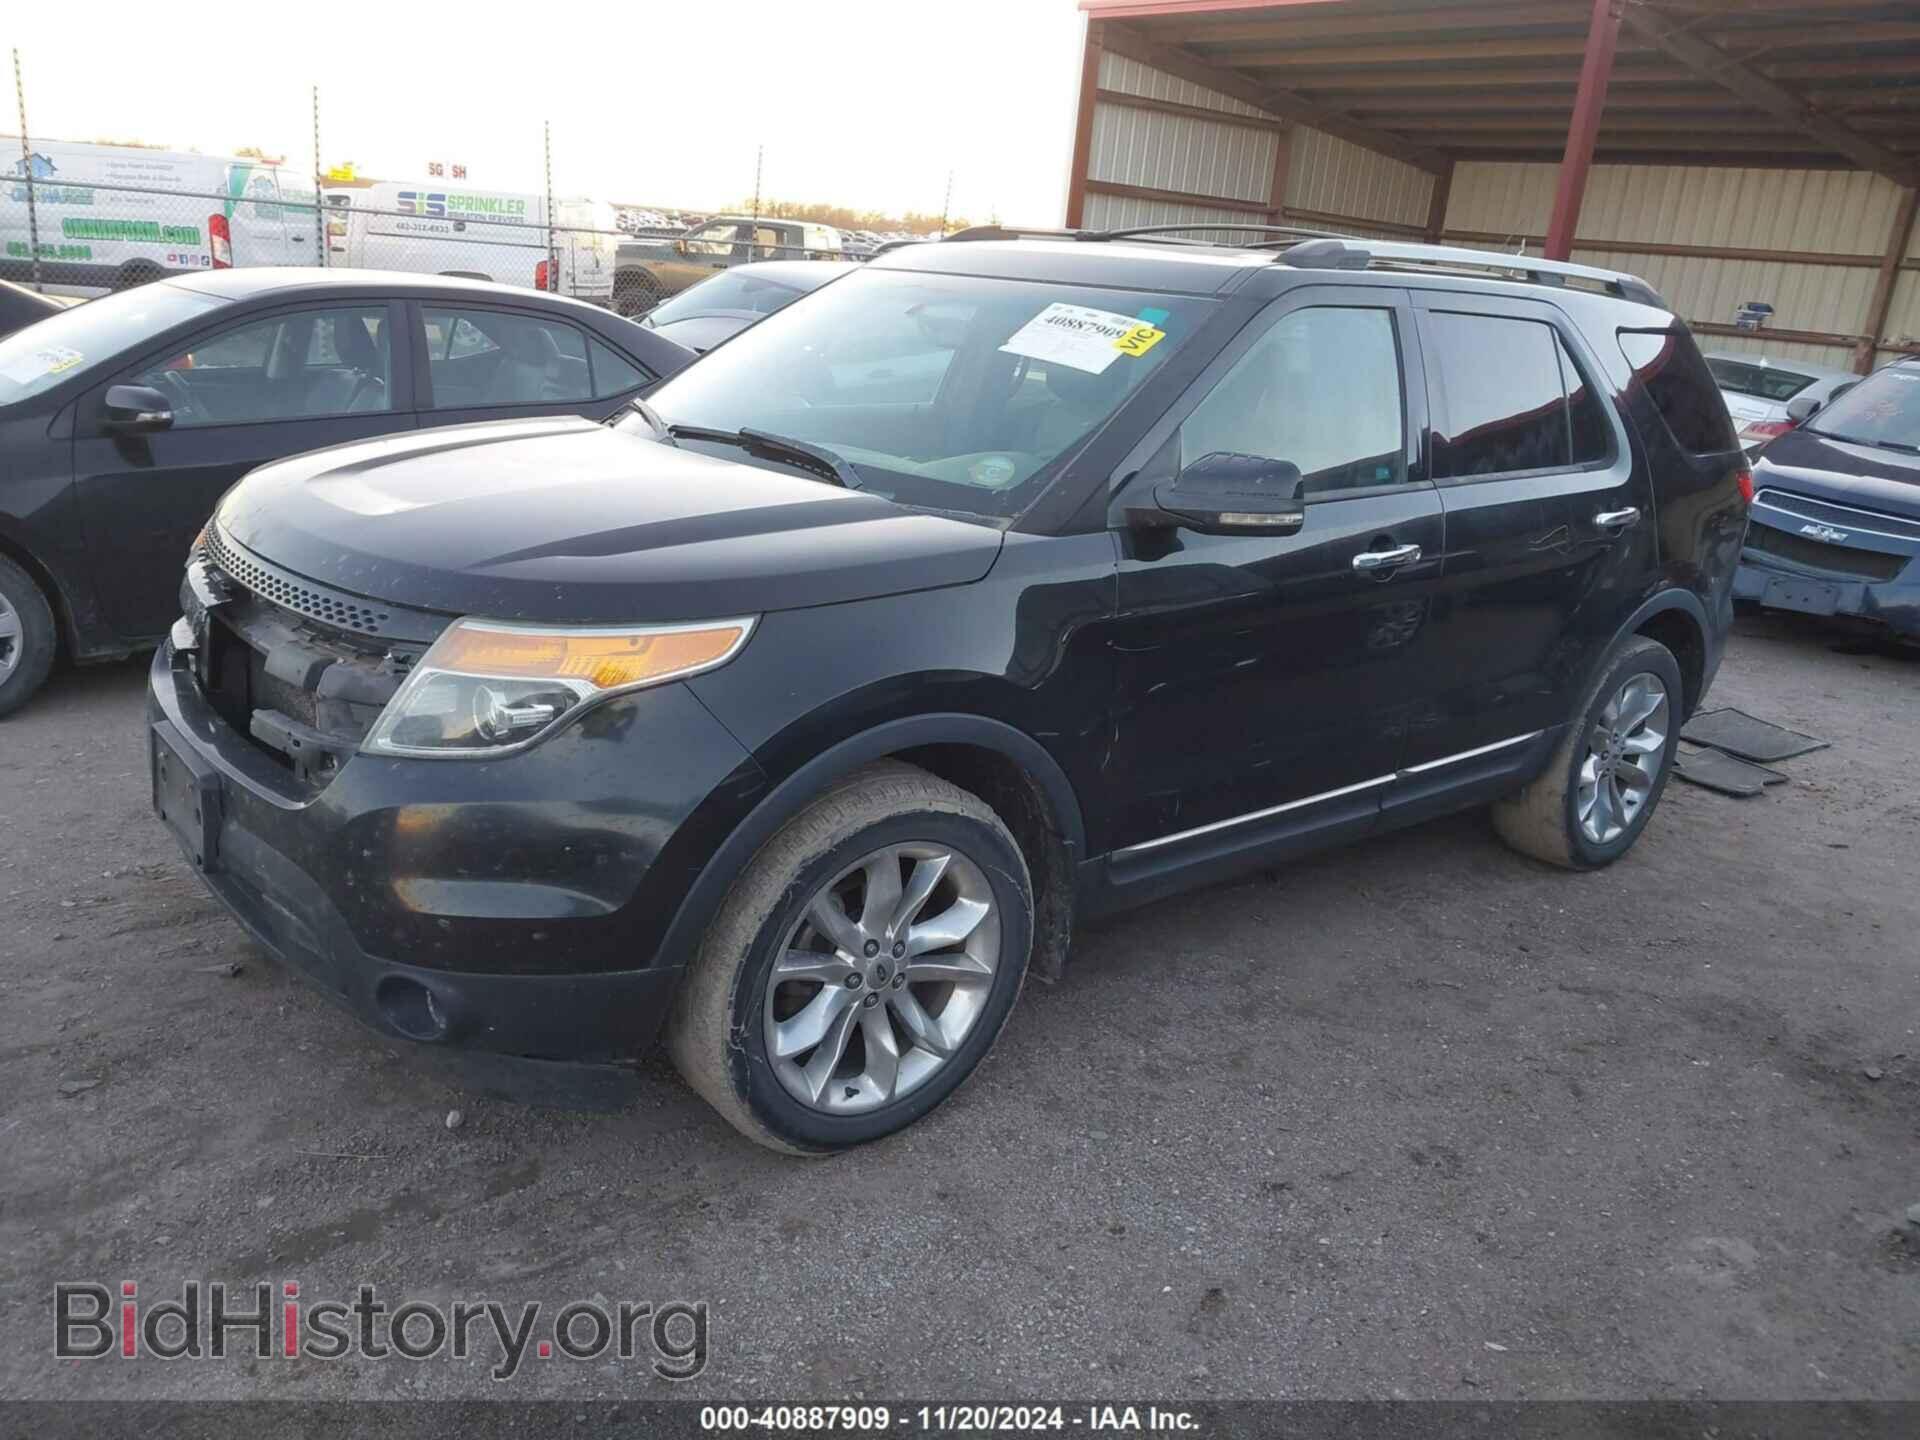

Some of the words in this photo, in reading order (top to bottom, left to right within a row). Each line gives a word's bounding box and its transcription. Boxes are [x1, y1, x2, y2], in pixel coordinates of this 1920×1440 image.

[447, 195, 524, 214] SPRINKLER
[1044, 314, 1127, 339] 40887909
[1119, 328, 1156, 351] VIC
